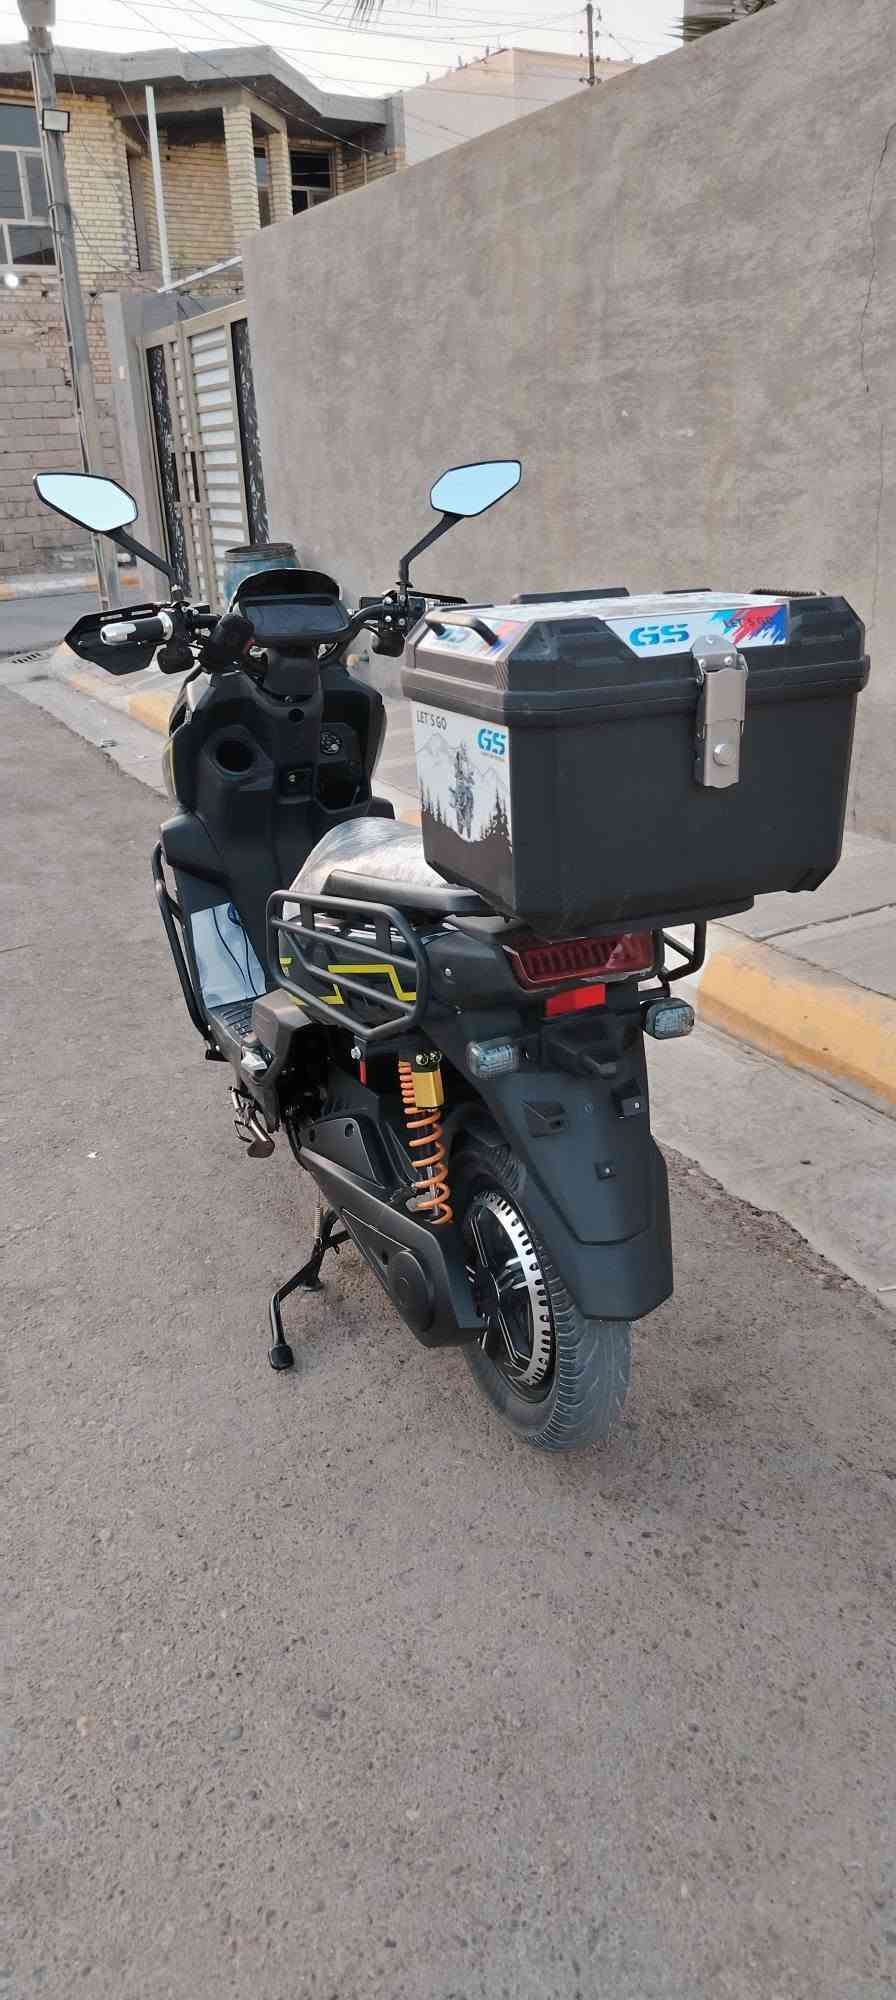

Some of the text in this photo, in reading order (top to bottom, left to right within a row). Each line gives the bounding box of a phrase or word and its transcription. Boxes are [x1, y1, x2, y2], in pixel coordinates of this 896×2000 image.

[629, 623, 690, 646] GS
[436, 715, 447, 730] GO
[478, 728, 506, 755] GS
